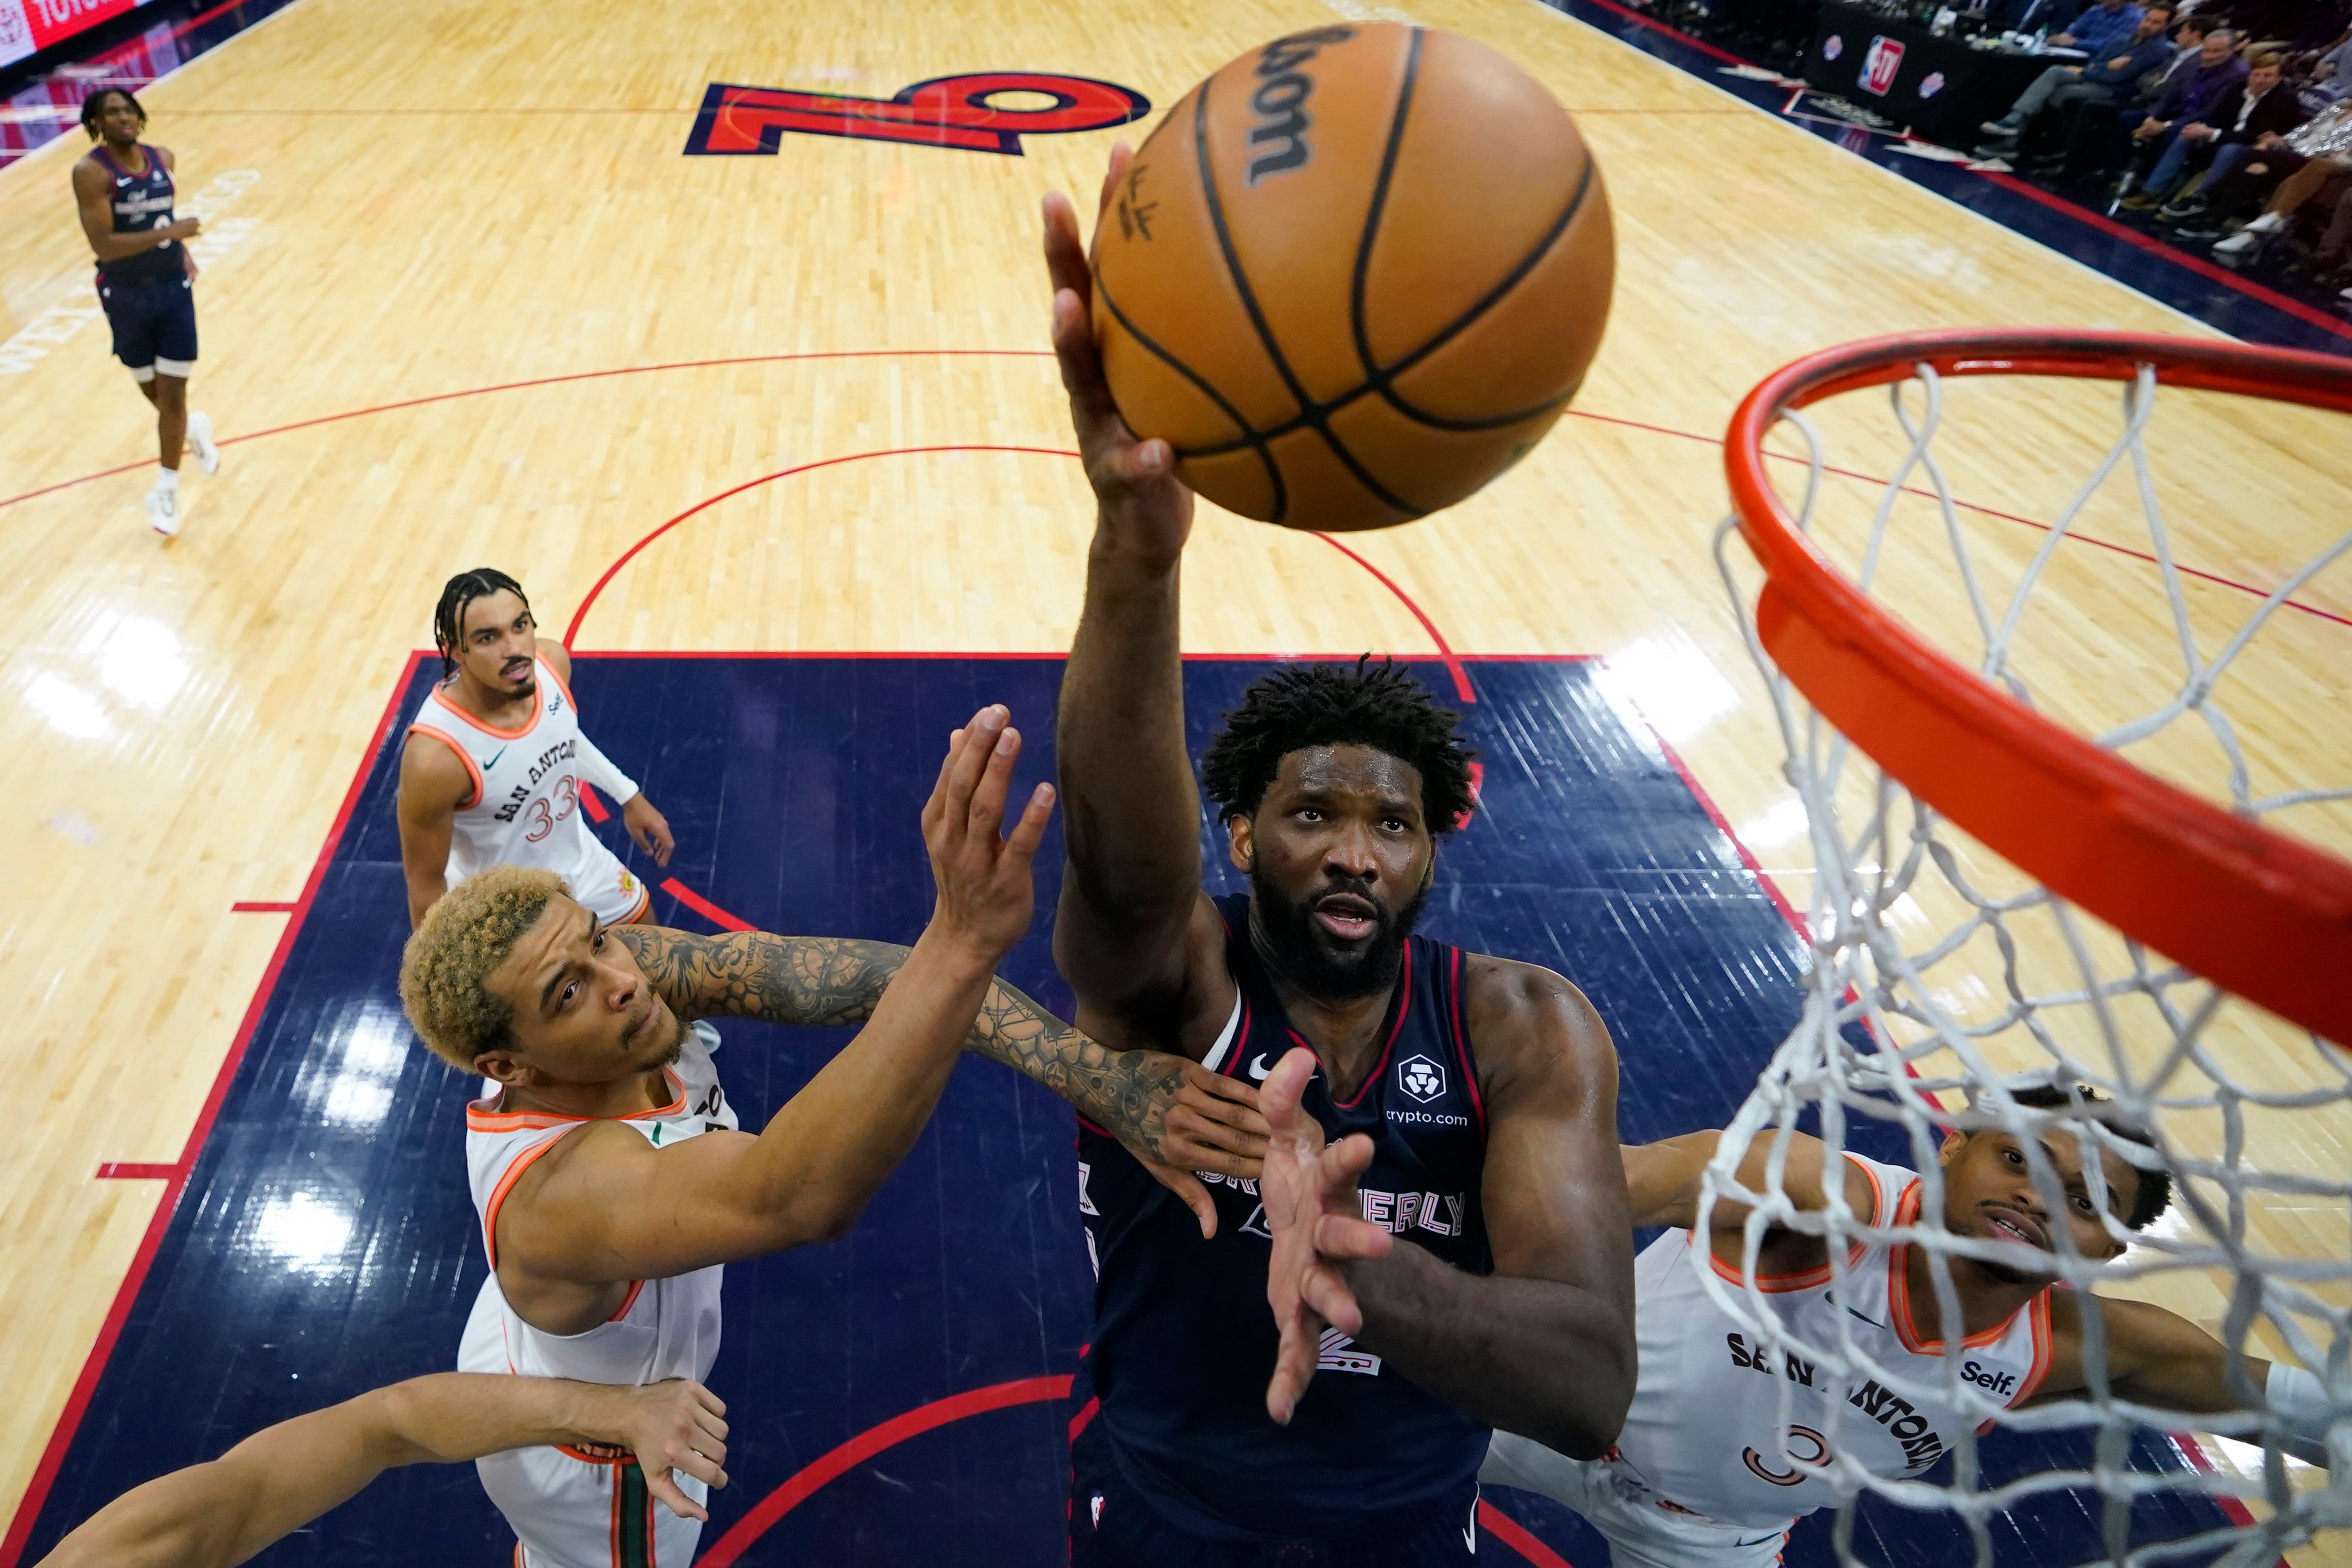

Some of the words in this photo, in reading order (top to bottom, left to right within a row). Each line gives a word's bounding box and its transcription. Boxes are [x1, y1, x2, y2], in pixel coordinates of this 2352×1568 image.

[494, 785, 530, 823] SAN
[524, 775, 578, 843] 33
[1386, 1109, 1468, 1127] crypto.com
[1960, 1361, 2016, 1396] Self.
